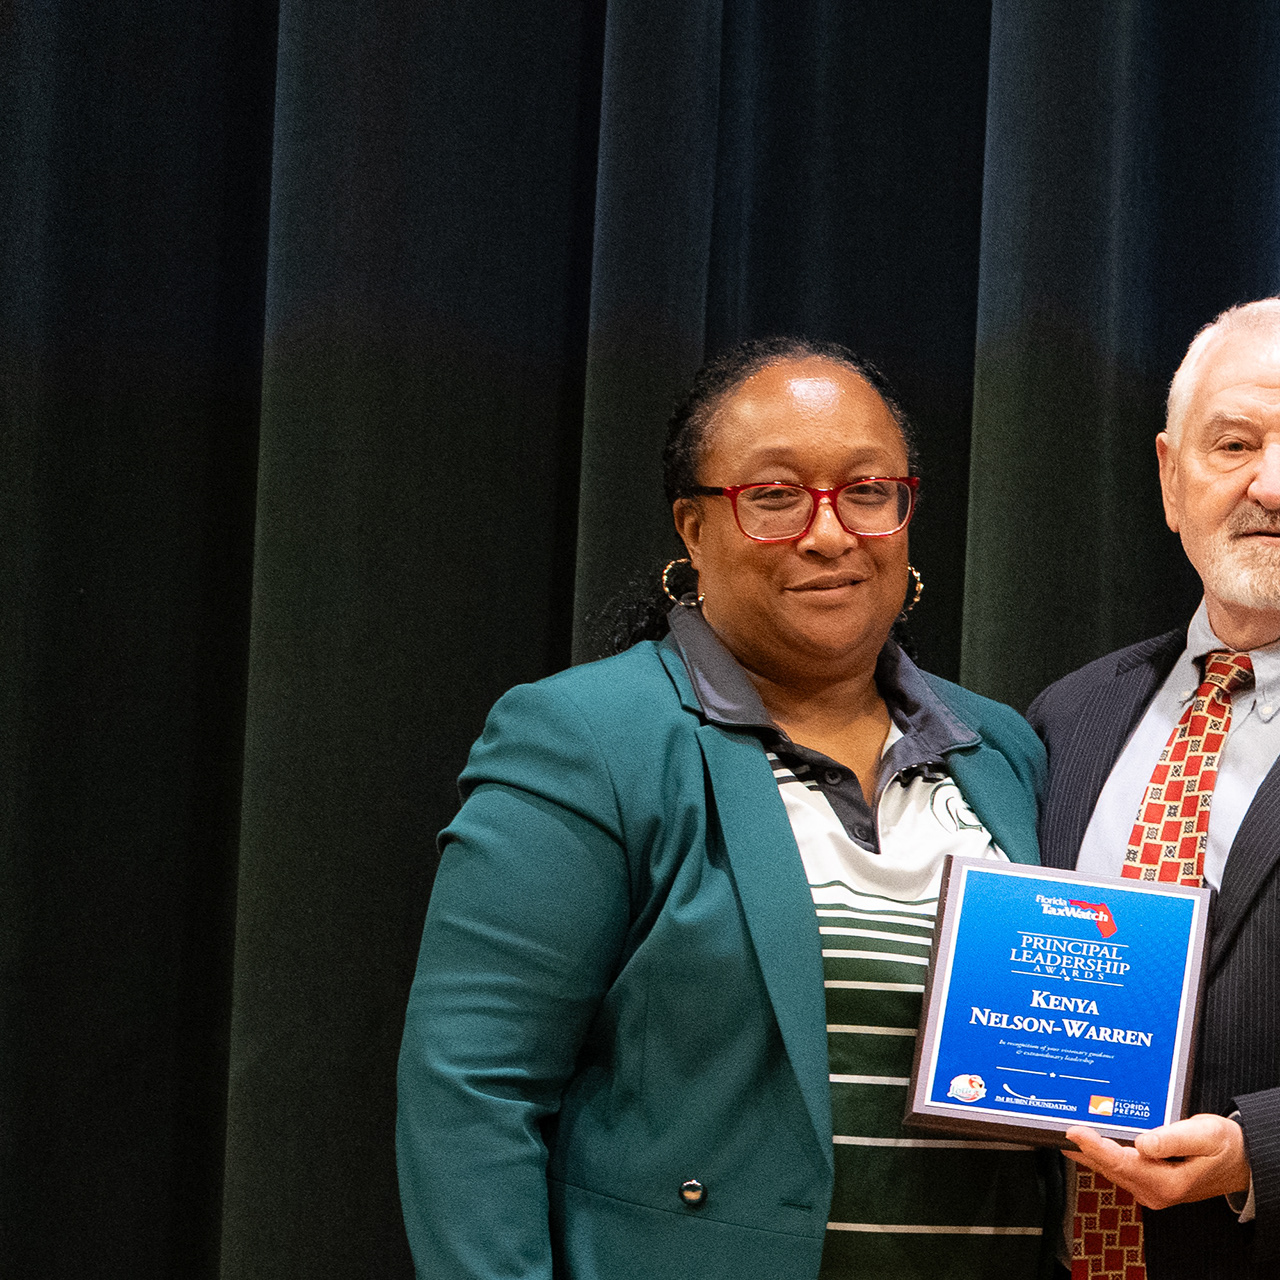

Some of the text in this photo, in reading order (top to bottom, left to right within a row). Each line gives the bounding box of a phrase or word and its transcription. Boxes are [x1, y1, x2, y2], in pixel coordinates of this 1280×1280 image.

[1036, 895, 1067, 906] Florida
[1041, 904, 1108, 923] TaxWatch
[1021, 935, 1122, 960] PRINCIPAL
[1010, 948, 1130, 975] LEADERSHIP
[1034, 965, 1105, 980] AWARDS
[1031, 990, 1099, 1015] KENYA
[969, 1007, 1153, 1047] NELSON-WARREN
[1029, 1099, 1077, 1112] FOUNDATION
[1114, 1101, 1150, 1111] FLORIDA
[1114, 1108, 1150, 1117] PREPAID
